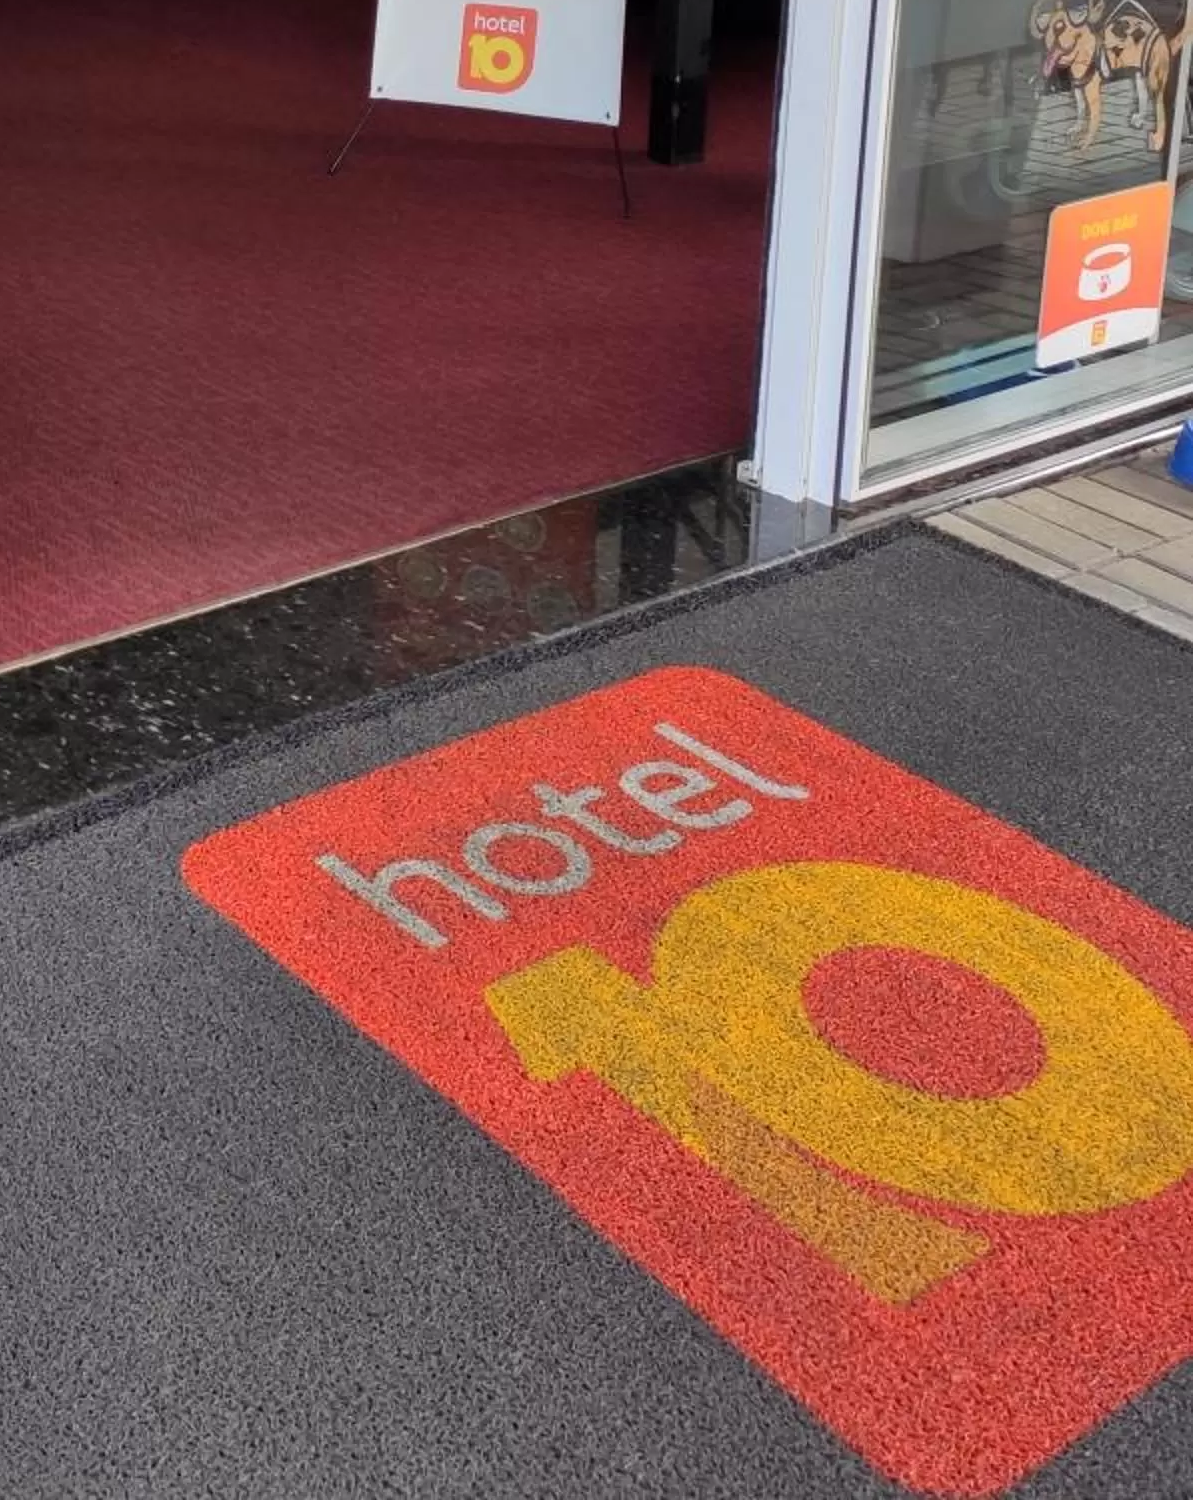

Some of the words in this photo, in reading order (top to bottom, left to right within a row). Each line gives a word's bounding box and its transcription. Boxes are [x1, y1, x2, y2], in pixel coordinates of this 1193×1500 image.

[468, 33, 524, 84] 10
[474, 11, 526, 36] hotel
[317, 722, 809, 952] hotel
[482, 859, 1193, 1307] 10
